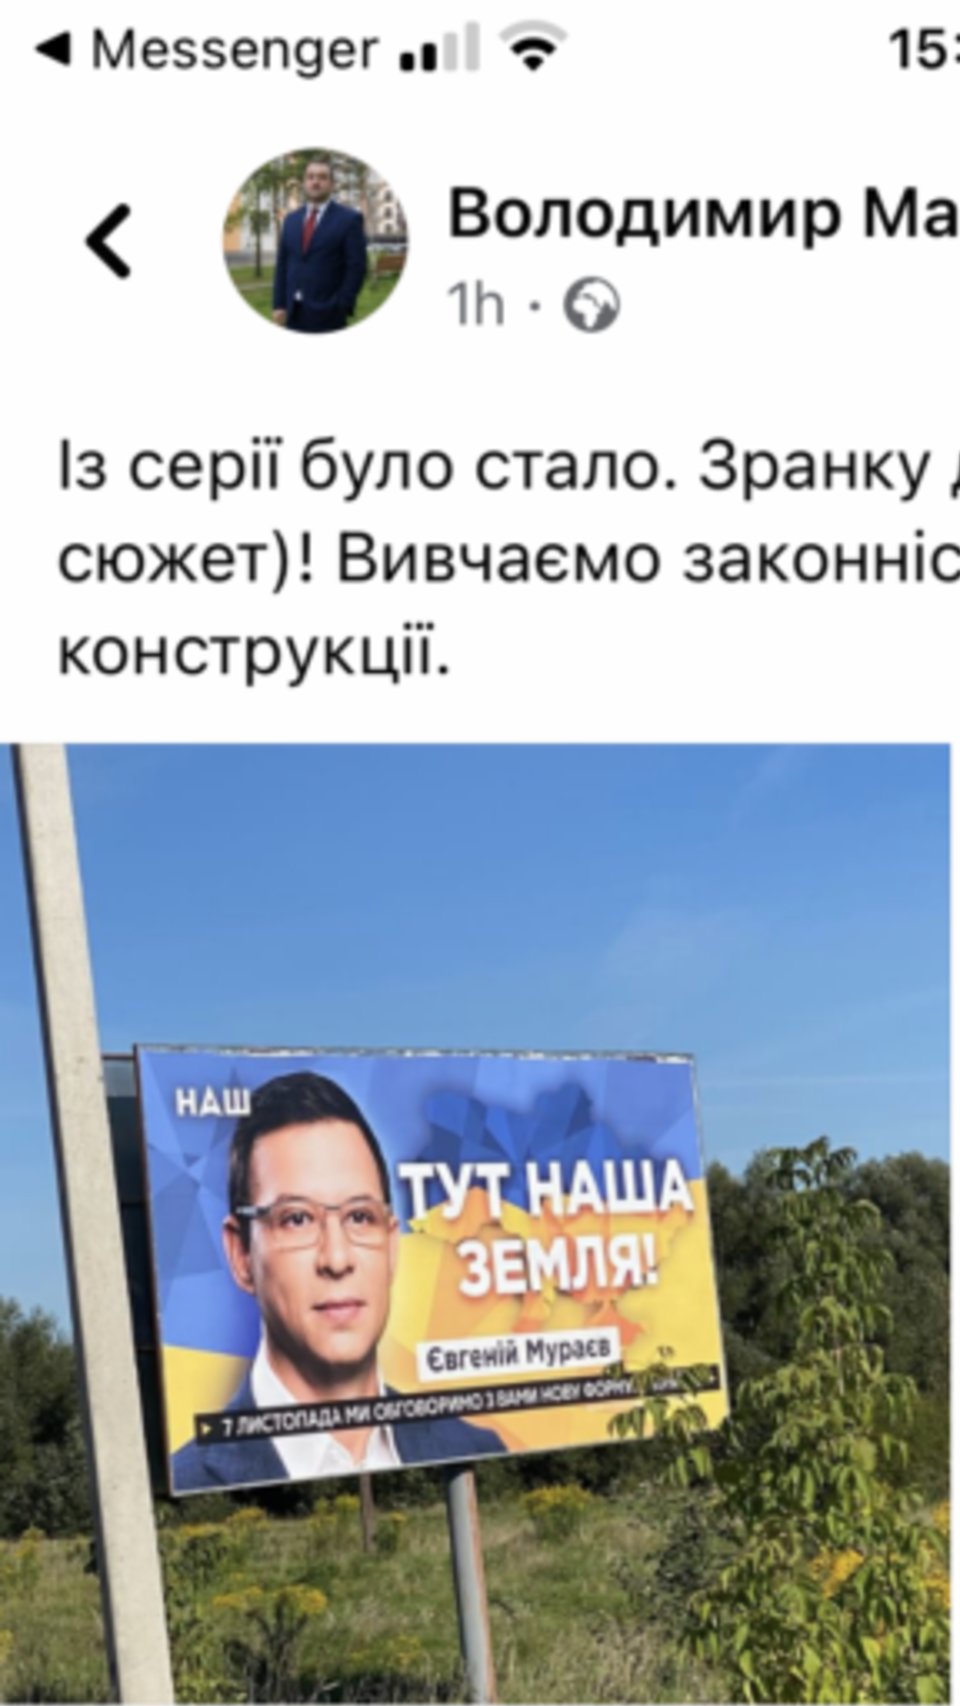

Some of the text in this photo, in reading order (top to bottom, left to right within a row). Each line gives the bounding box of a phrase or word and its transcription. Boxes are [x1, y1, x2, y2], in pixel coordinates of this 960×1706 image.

[92, 27, 380, 80] Messenger
[449, 185, 842, 251] Володимир
[448, 279, 504, 326] 1h
[60, 438, 107, 491] Із
[129, 435, 284, 503] серії
[300, 435, 454, 503] було
[475, 449, 677, 491] стало.
[699, 436, 931, 503] Зранку
[58, 528, 312, 595] сюжет)!
[338, 530, 661, 584] Вивчаємо
[59, 621, 449, 688] конструкції.
[175, 1085, 252, 1117] НАШ
[398, 1158, 695, 1221] ТУТ НАША
[457, 1233, 660, 1297] ЗЕМЛЯ!
[426, 1338, 611, 1372] Євгеній Мураєв
[236, 1406, 342, 1437] ЛИСТОПАДА
[345, 1402, 371, 1424] МИ
[373, 1392, 483, 1421] ОБГОВОРИМО
[497, 1386, 538, 1408] ВАМИ
